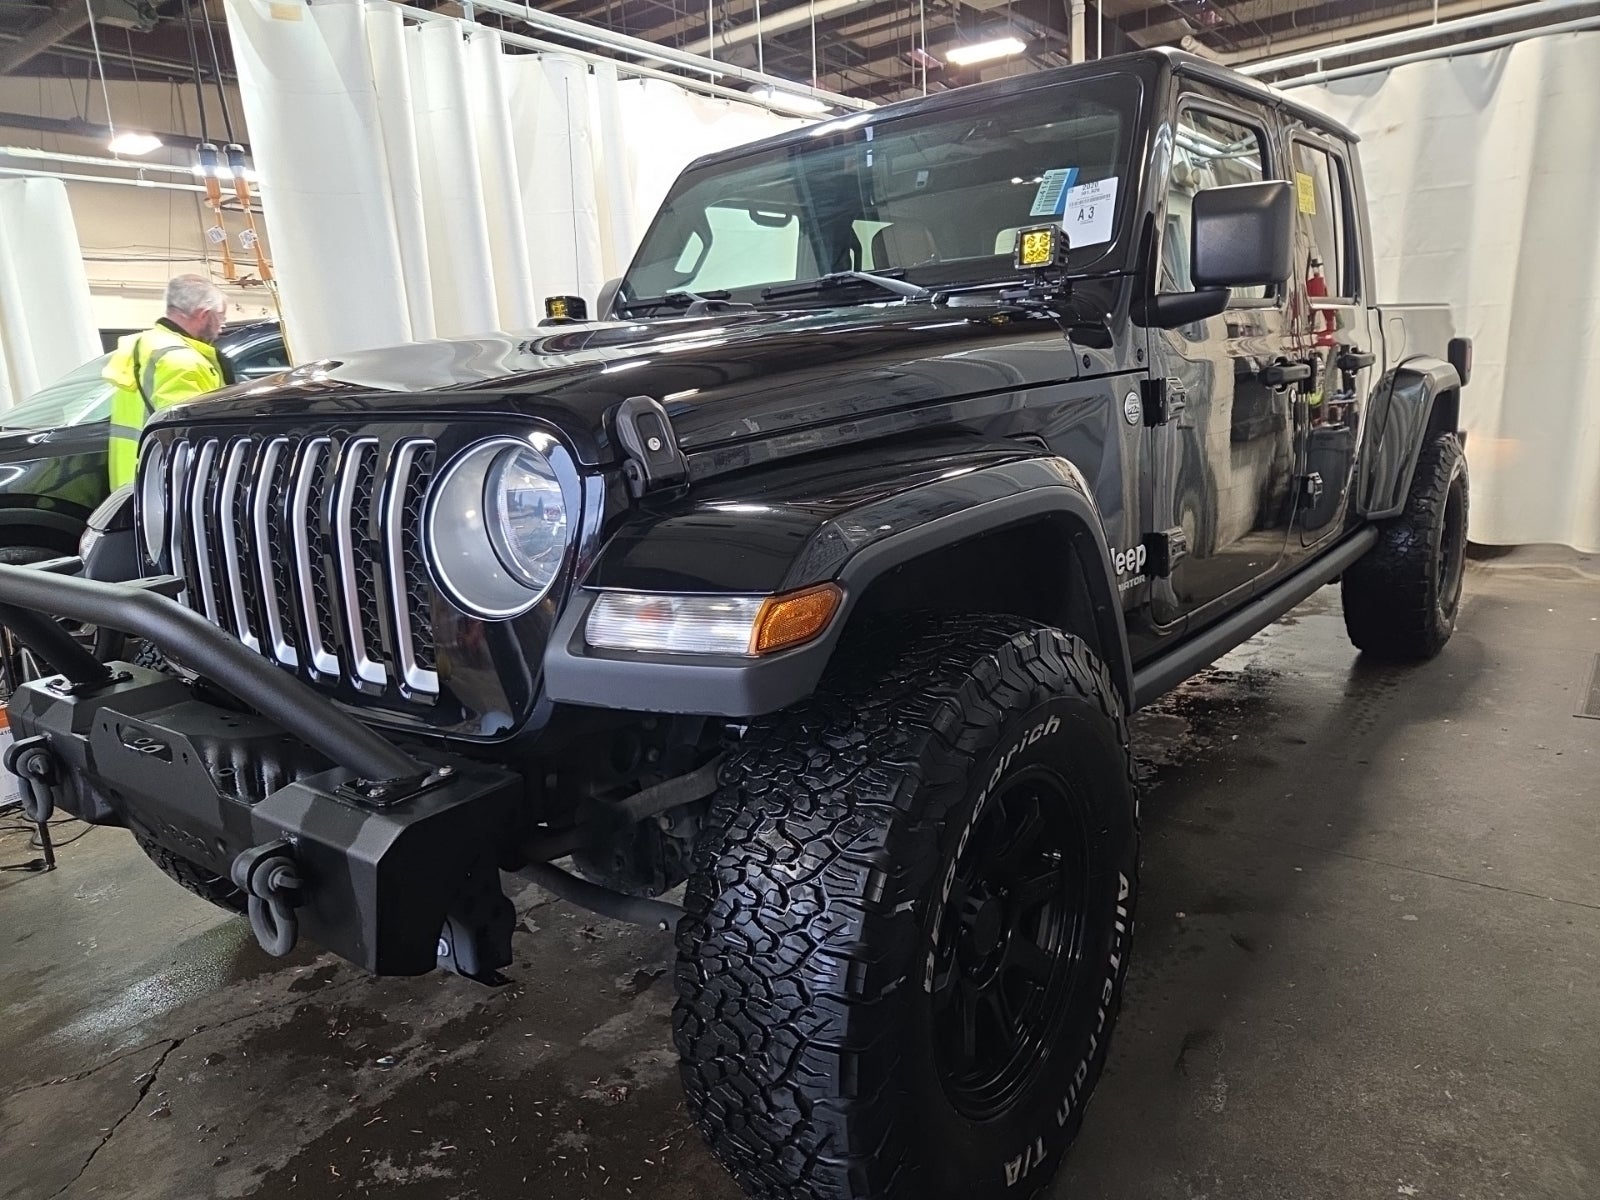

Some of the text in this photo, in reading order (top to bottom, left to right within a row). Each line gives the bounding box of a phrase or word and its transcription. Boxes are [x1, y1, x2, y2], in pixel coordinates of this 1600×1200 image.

[1077, 206, 1095, 222] A 3
[1003, 871, 1130, 1187] All-Terrain T/A
